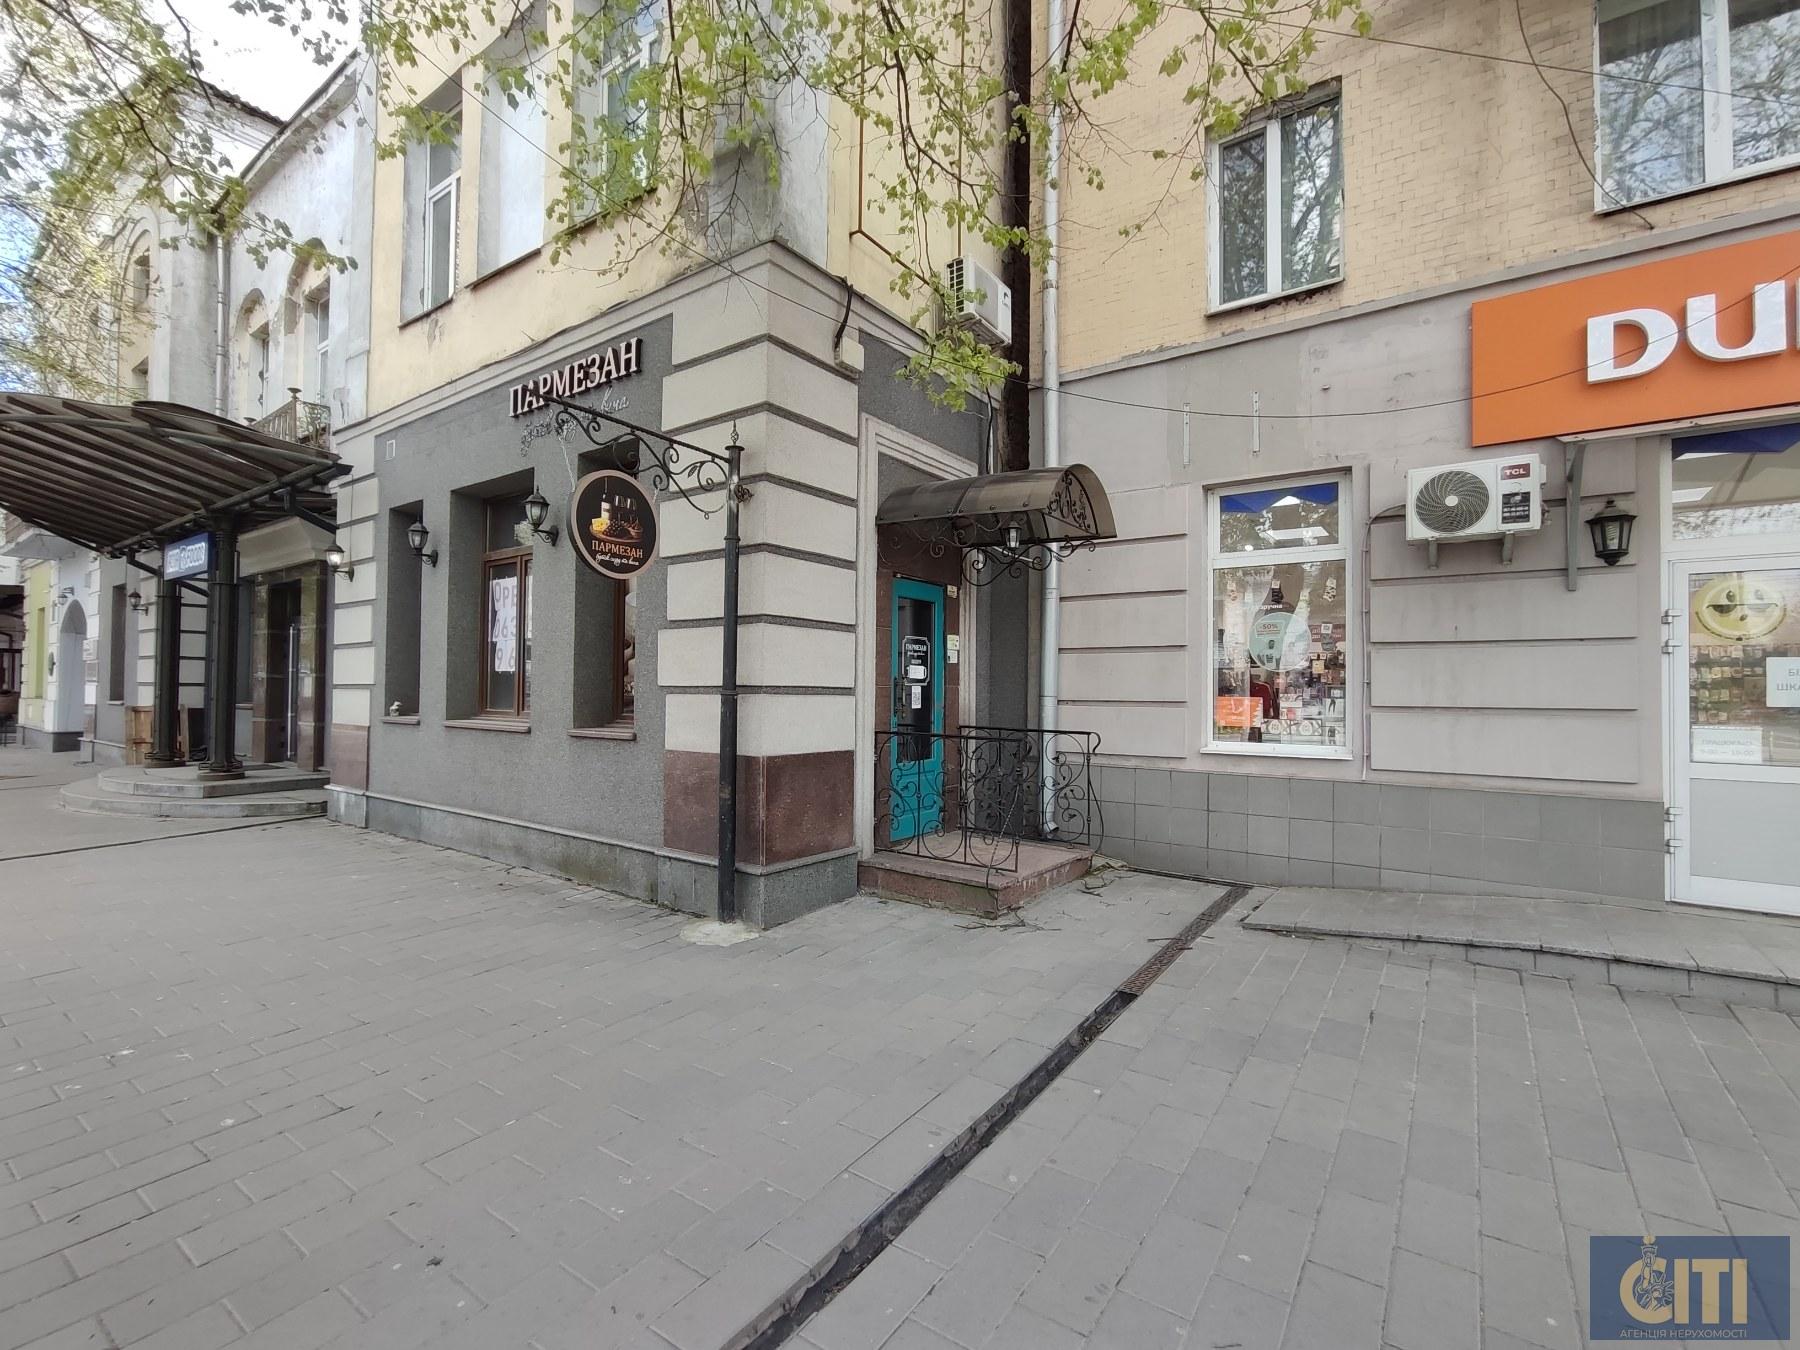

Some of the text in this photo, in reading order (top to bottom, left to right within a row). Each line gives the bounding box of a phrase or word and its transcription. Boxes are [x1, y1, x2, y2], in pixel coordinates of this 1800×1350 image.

[508, 337, 641, 417] ПАРМЕЗАН
[1503, 468, 1527, 476] TCL
[592, 540, 643, 558] ПАРМЕЗАН
